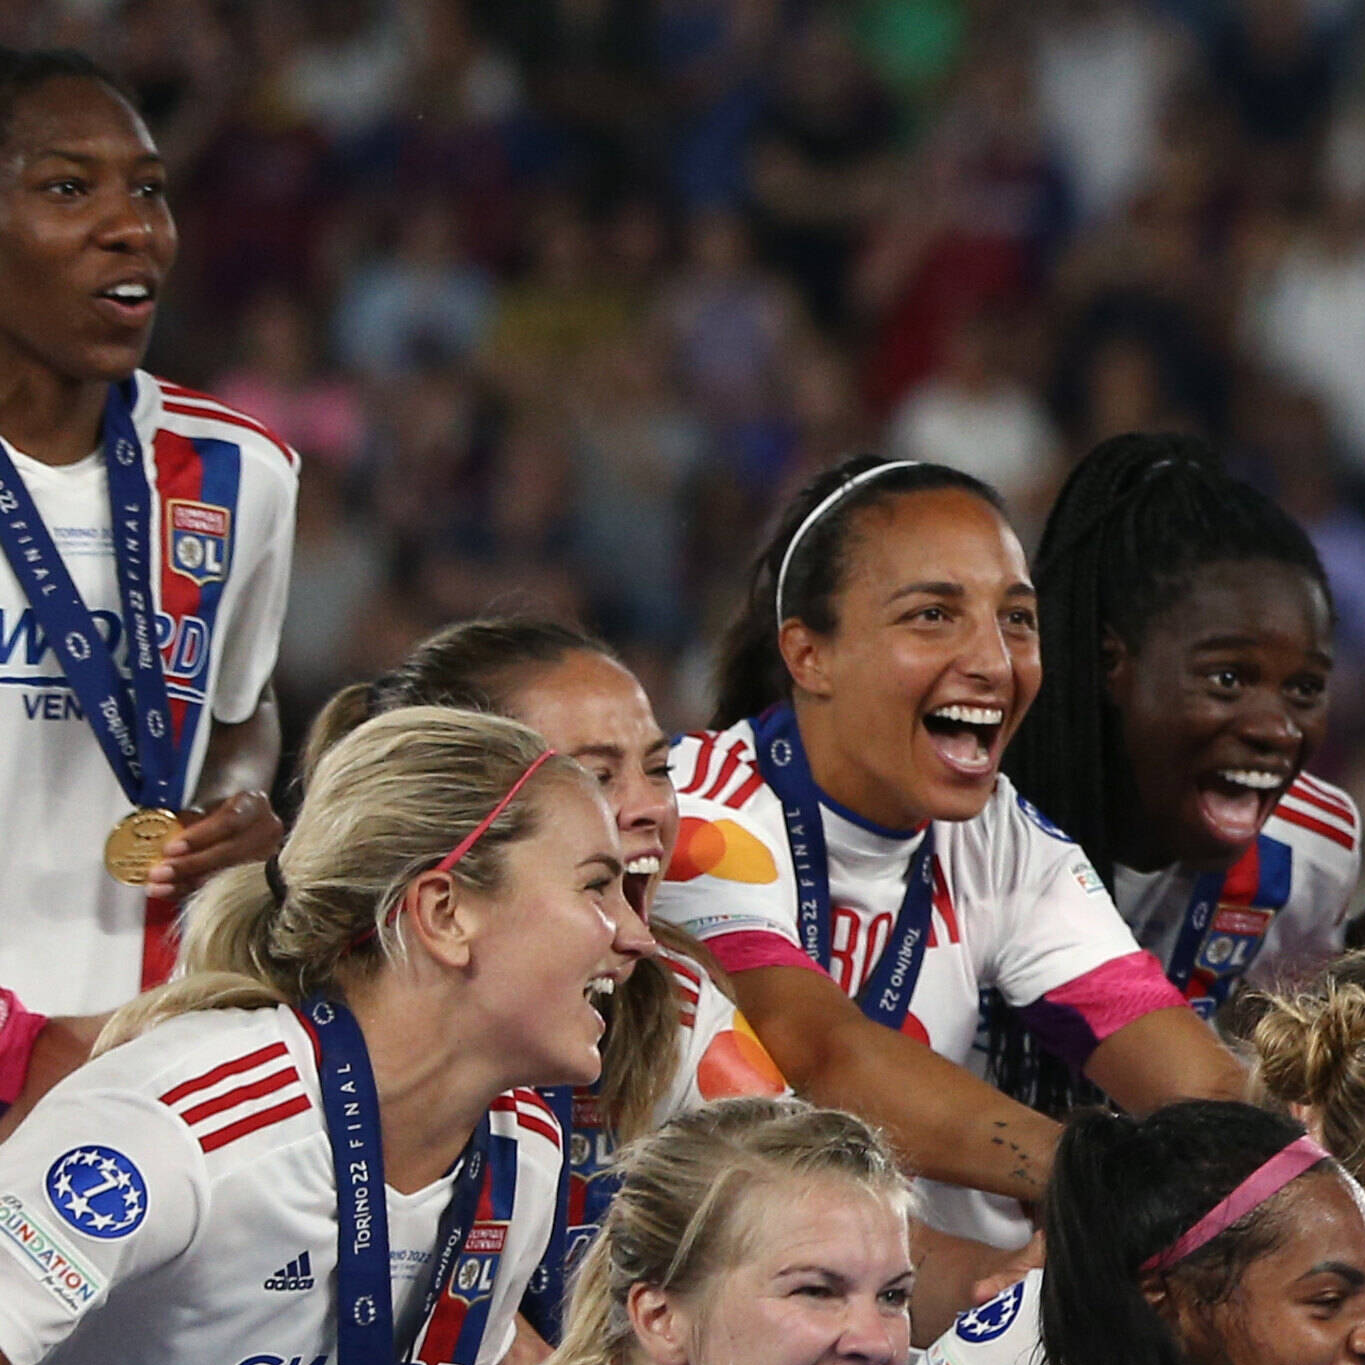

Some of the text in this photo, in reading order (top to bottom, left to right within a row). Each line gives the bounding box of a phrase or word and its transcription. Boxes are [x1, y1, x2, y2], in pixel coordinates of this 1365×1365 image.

[11, 521, 57, 597] FINAL
[127, 501, 141, 581] FINAL
[176, 535, 223, 574] OL
[130, 614, 154, 670] TORINO
[22, 694, 87, 721] VEN
[786, 807, 817, 921] 22 FINAL
[880, 927, 921, 1012] TORINO 22
[337, 1063, 372, 1254] TORINO 22 FINAL
[0, 1204, 95, 1302] OUNDATION
[458, 1257, 494, 1293] OL
